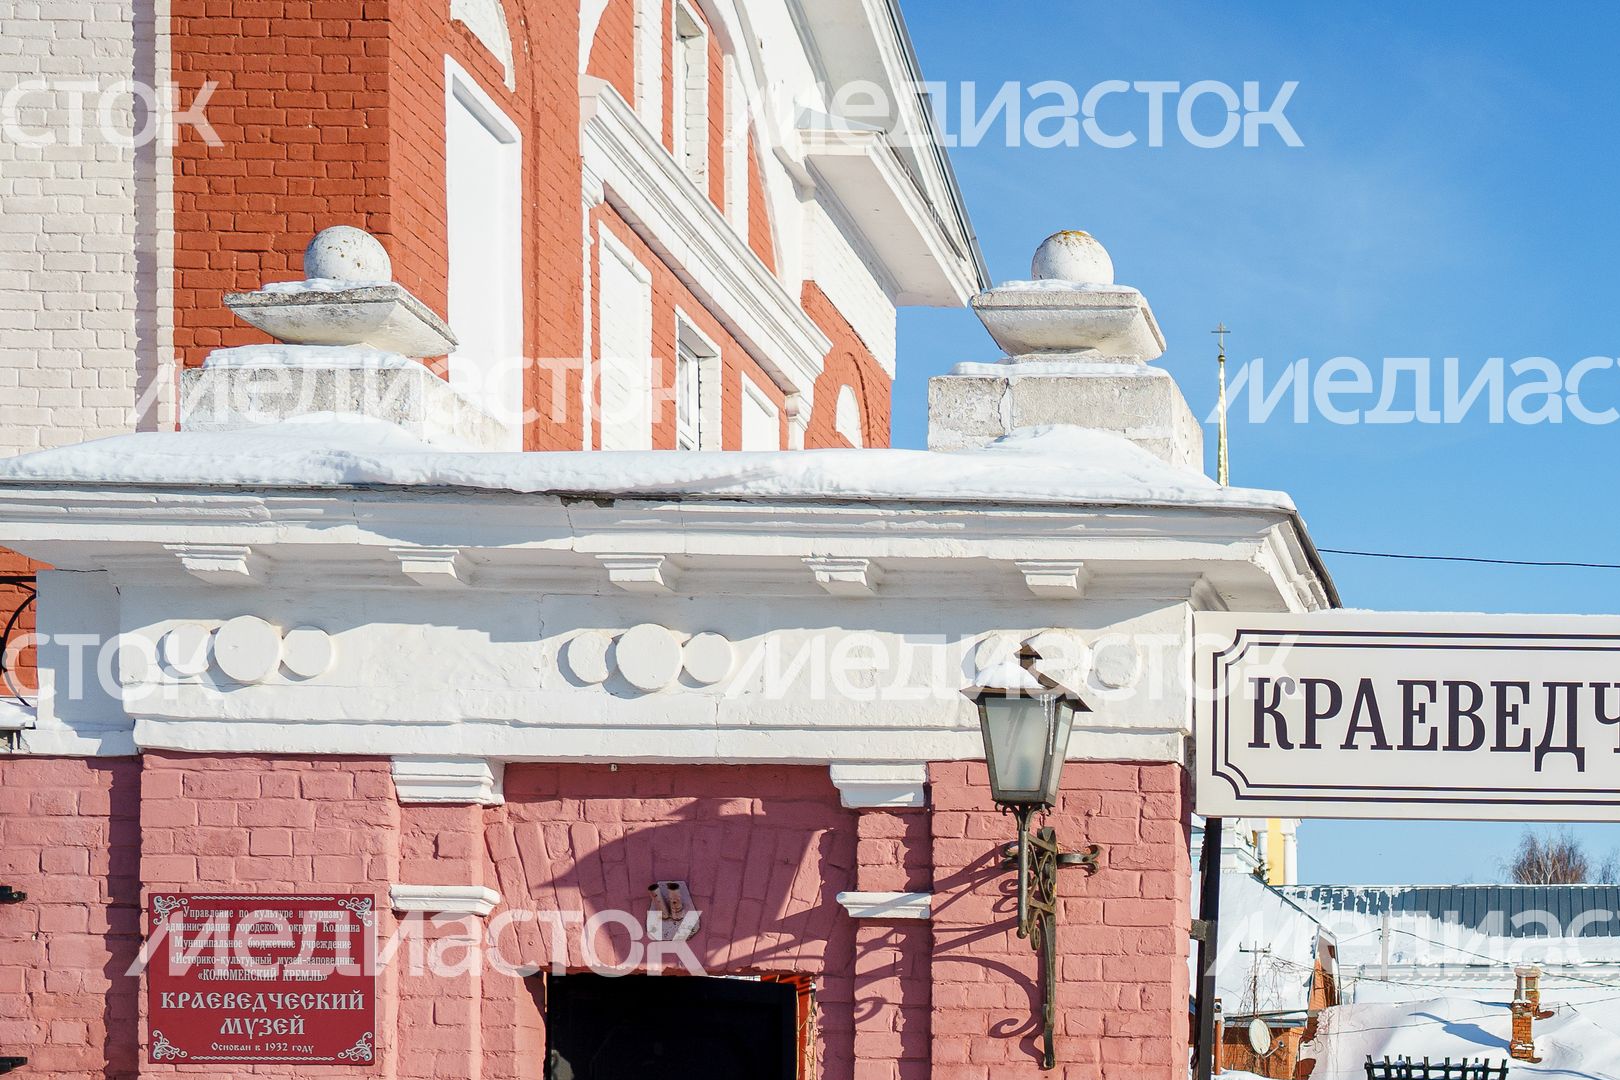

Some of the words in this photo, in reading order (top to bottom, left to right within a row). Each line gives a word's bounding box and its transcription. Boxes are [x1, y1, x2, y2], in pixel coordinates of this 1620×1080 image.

[183, 906, 234, 921] Управление
[239, 910, 249, 919] по
[254, 908, 294, 921] культуре
[298, 910, 304, 919] и
[309, 910, 344, 921] туризму
[166, 922, 231, 934] администрации
[236, 922, 284, 933] городского
[288, 922, 316, 934] округа
[322, 921, 360, 932] Коломна
[174, 937, 243, 950] Муниципальное
[248, 936, 296, 949] бюджетное
[301, 938, 352, 950] учреждение
[277, 954, 355, 966] музей-заповедник
[198, 968, 277, 982] «КОЛОМЕНСКИЙ
[282, 970, 328, 982] КРЕМЛЬ»
[161, 990, 364, 1012] КРАЕВЕДЧЕСКИЙ
[220, 1015, 305, 1039] МУЗЕЙ
[211, 1042, 252, 1052] Основан
[255, 1044, 261, 1052] в
[264, 1042, 288, 1052] 1932
[292, 1044, 314, 1055] году
